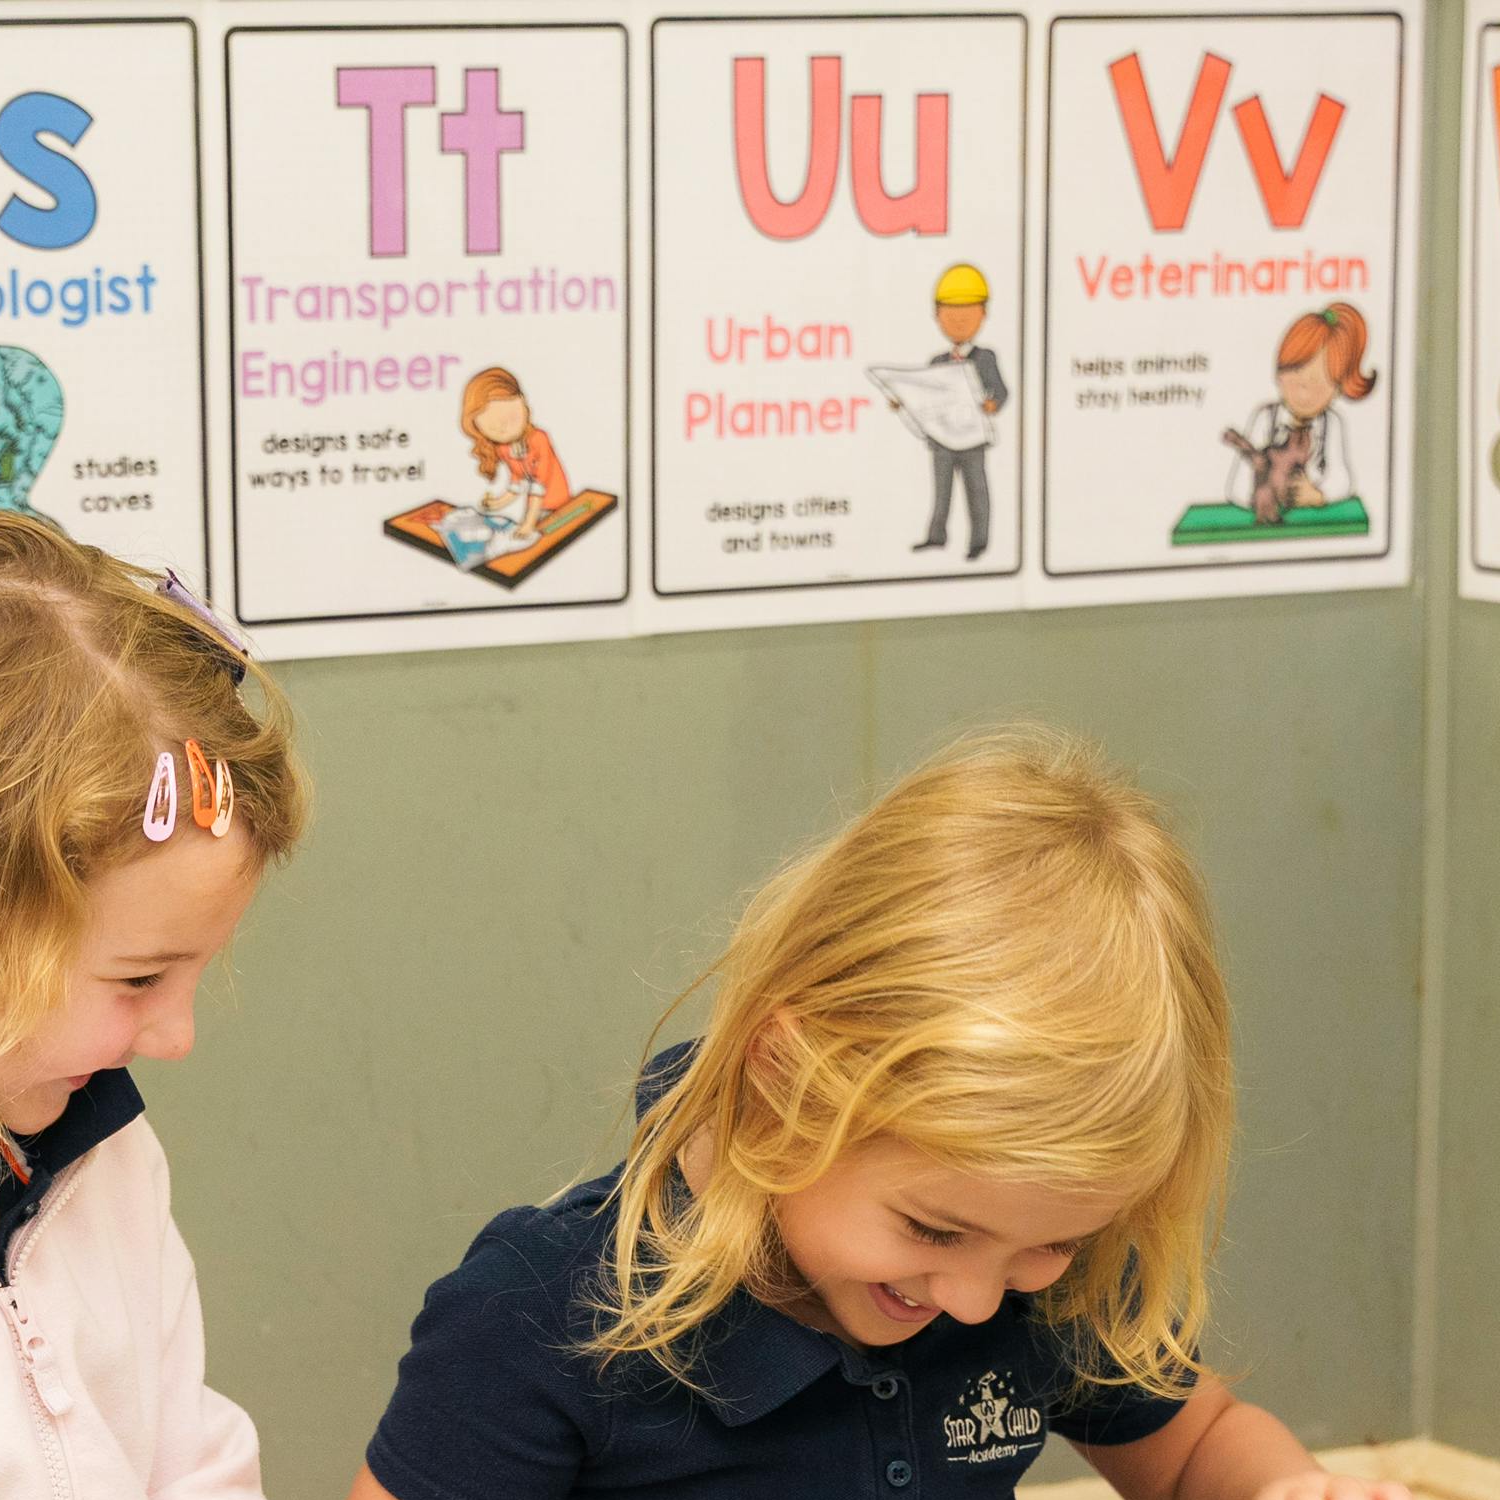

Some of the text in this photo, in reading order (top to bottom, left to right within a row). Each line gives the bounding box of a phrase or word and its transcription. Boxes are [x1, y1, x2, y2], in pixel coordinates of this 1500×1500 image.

[732, 56, 950, 240] Uu
[1107, 51, 1346, 231] Vv
[336, 65, 525, 257] Tt
[1077, 250, 1370, 300] Veterinarian
[241, 267, 617, 328] Transportation
[704, 316, 852, 363] Urban
[241, 350, 462, 405] Engineer
[1071, 351, 1210, 381] helps animals
[685, 391, 872, 440] Planner
[1076, 384, 1207, 412] stay healthy
[263, 427, 410, 458] designs safe
[73, 456, 159, 482] studies
[249, 459, 425, 491] ways to travel
[81, 489, 153, 512] caves
[706, 497, 850, 524] designs cities
[722, 532, 833, 554] and towns
[943, 1406, 1041, 1448] STAR CHILD
[968, 1443, 1018, 1464] Academy
